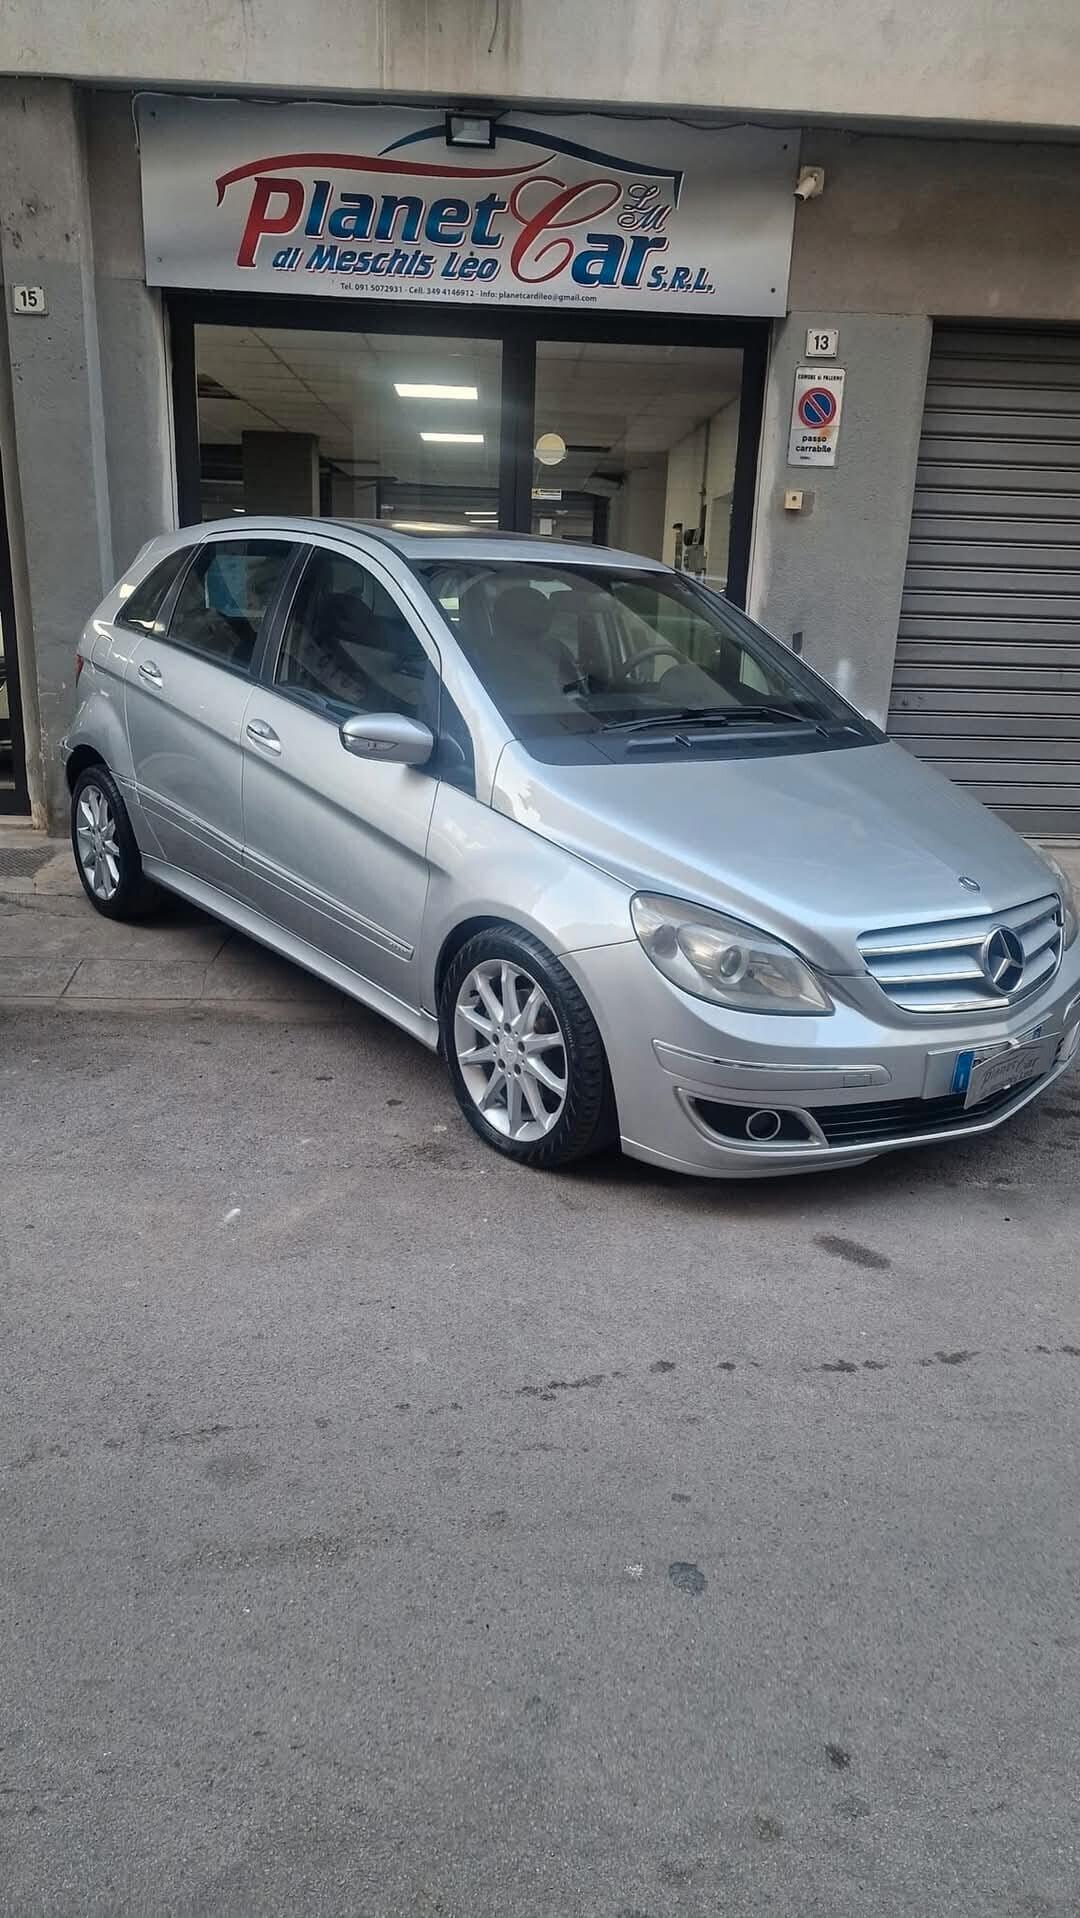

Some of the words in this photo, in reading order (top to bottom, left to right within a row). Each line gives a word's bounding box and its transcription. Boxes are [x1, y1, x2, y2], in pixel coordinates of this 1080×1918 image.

[237, 177, 508, 269] Planet
[510, 175, 669, 289] Car
[647, 265, 716, 294] S.R.L.
[305, 244, 436, 279] Meschis
[340, 282, 354, 291] Tel.
[354, 283, 369, 291] 091
[370, 284, 403, 293] 5072931
[408, 286, 424, 294] Cell.
[426, 287, 441, 295] 349
[441, 288, 474, 297] 4146912
[20, 290, 38, 307] 15
[814, 335, 829, 350] 13
[802, 435, 827, 443] passo
[795, 445, 832, 453] carrabile
